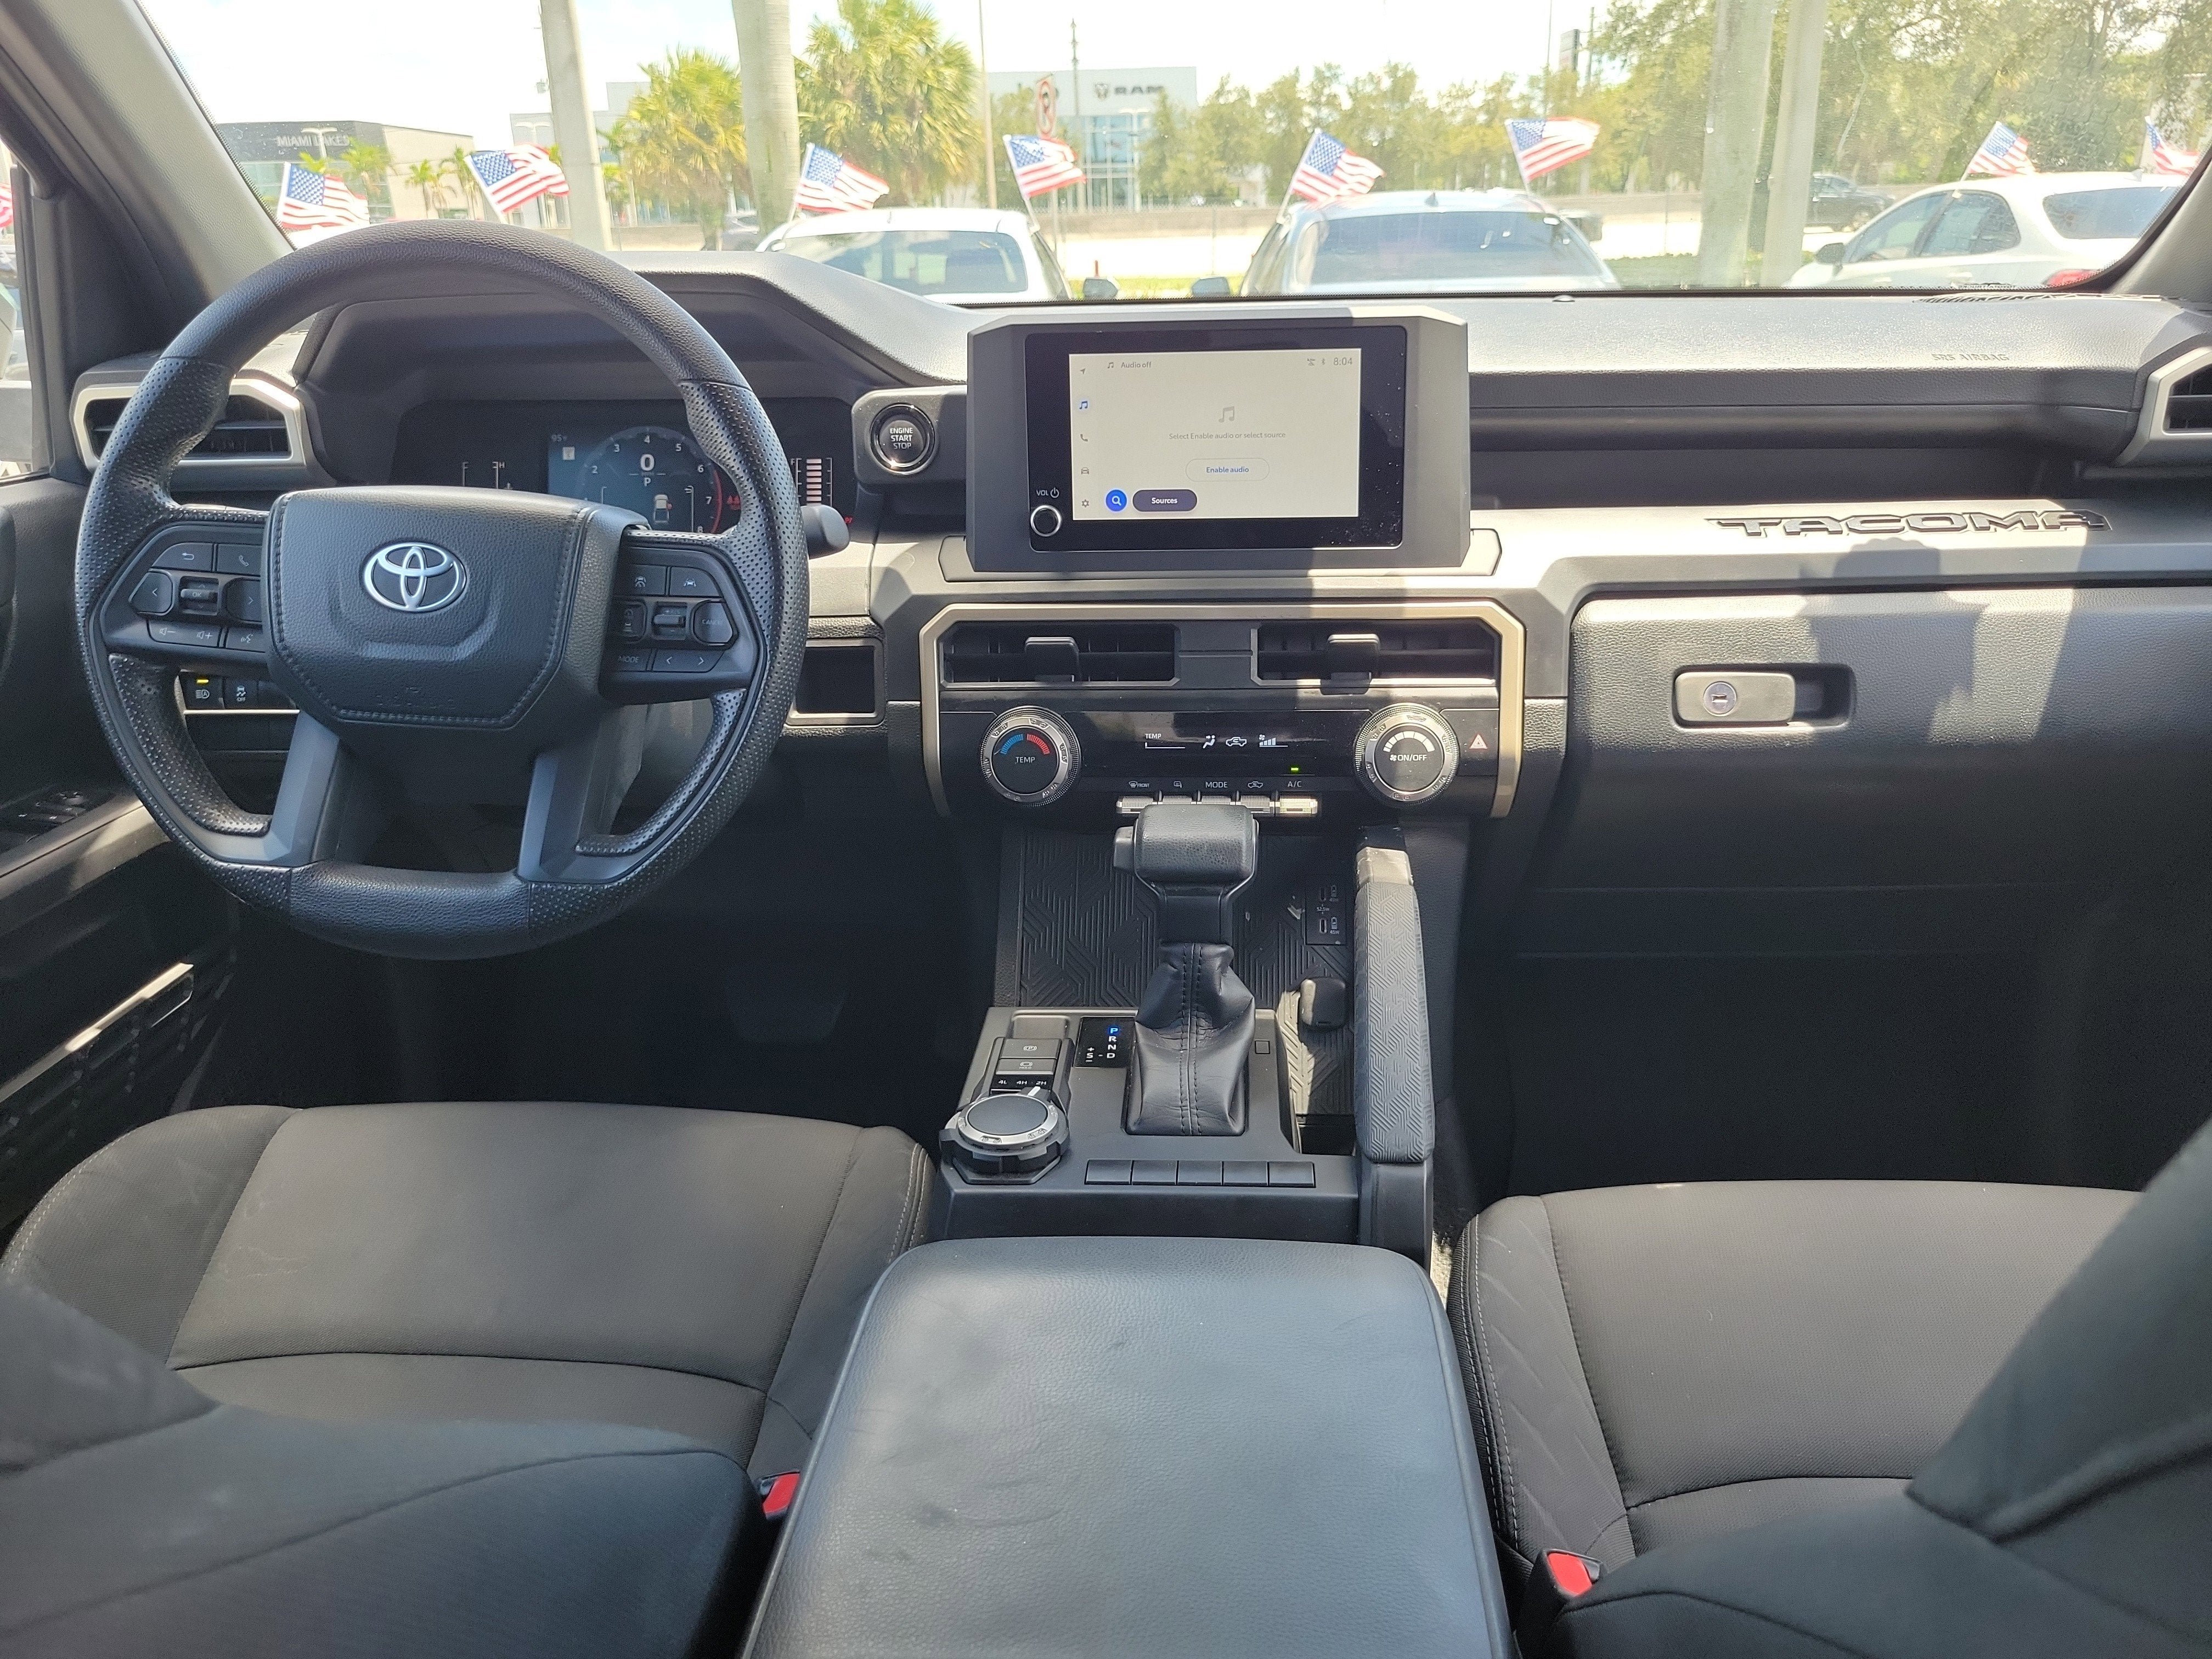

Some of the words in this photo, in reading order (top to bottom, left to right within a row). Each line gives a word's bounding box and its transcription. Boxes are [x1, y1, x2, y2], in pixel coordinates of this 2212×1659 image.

[1114, 86, 1164, 94] RAM
[277, 135, 313, 146] MIAMI
[1333, 357, 1353, 366] 8:04
[644, 435, 651, 444] 4
[614, 444, 620, 453] 3
[675, 443, 682, 452] 5
[592, 466, 598, 474] 2
[697, 465, 704, 473] 6
[644, 477, 651, 487] P
[706, 496, 712, 505] 7
[1704, 510, 2113, 538] TACOMA
[1397, 753, 1427, 761] ON/OFF
